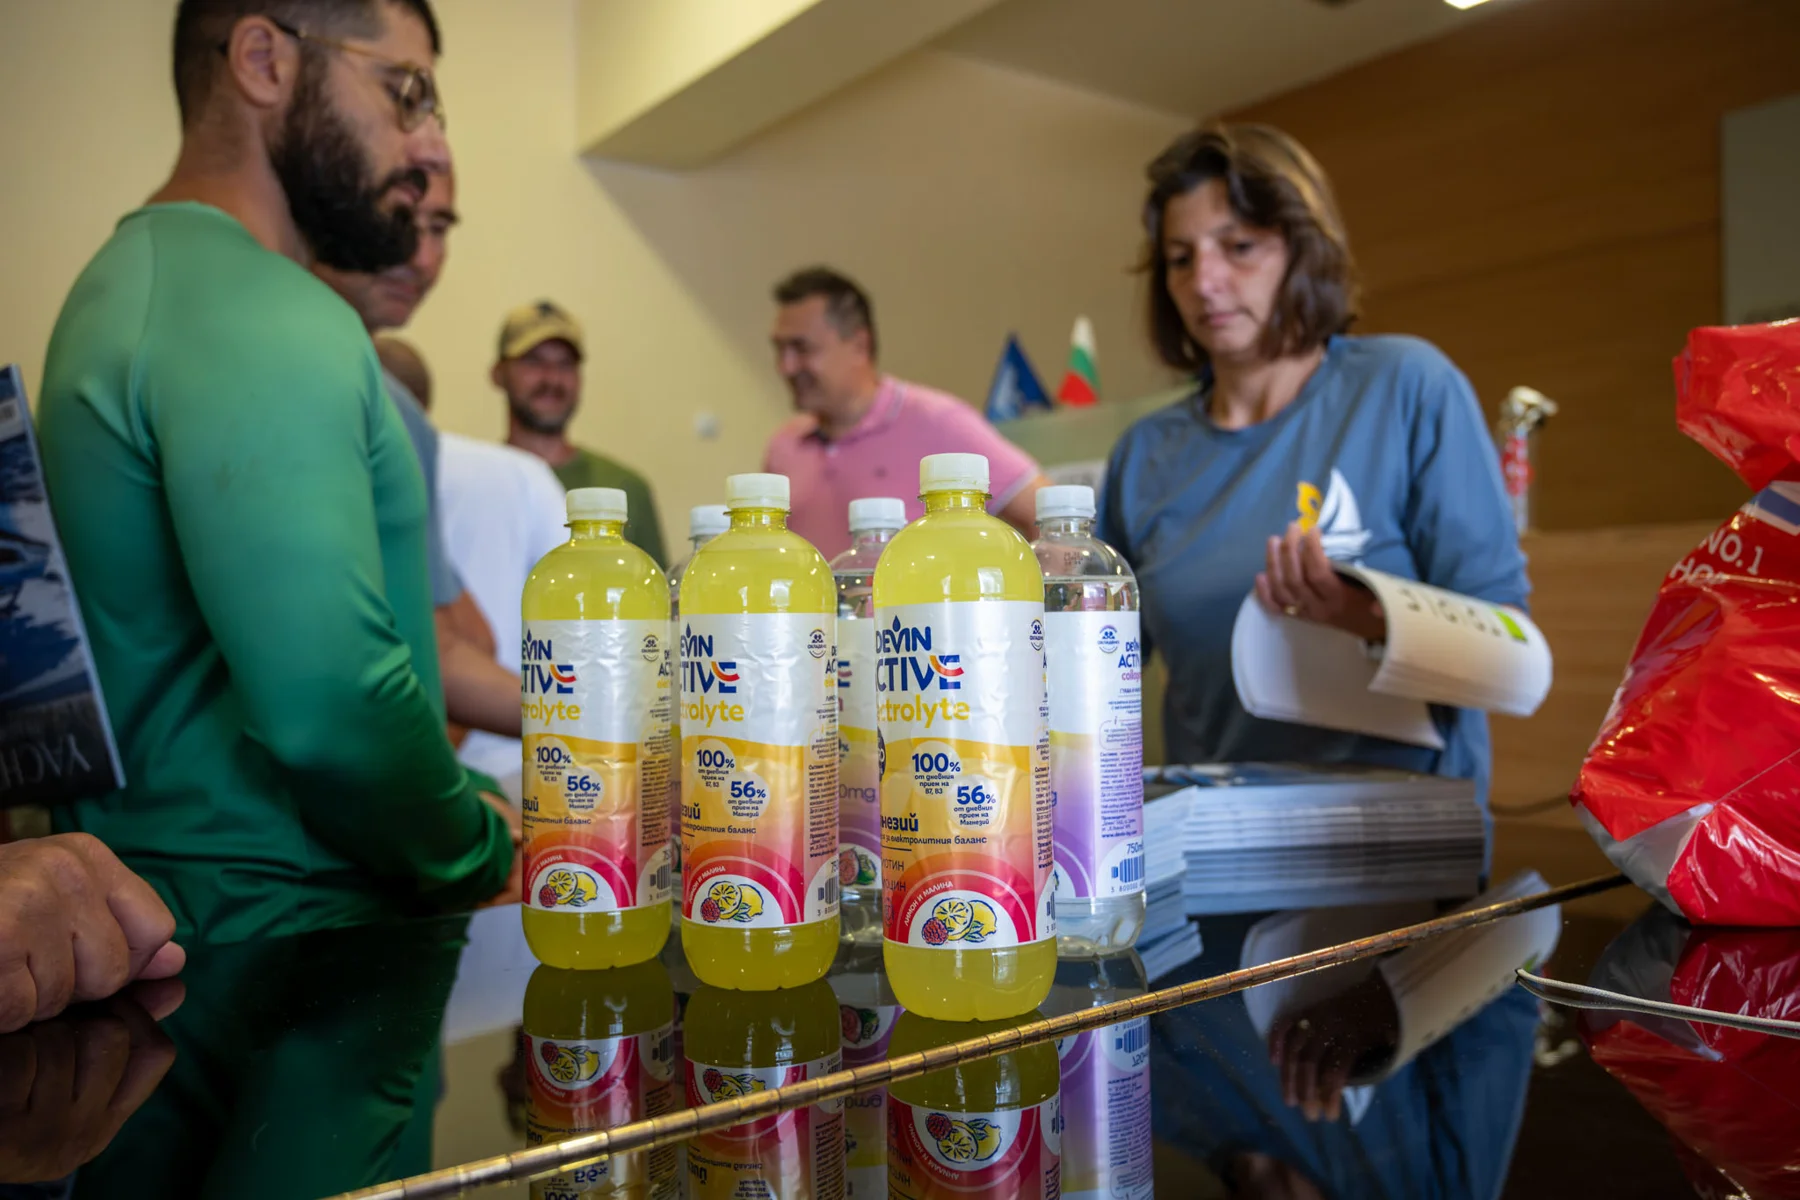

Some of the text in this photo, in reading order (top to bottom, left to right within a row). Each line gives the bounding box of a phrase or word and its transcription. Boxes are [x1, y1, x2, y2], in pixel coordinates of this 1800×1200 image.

[522, 639, 552, 661] EVIN
[680, 635, 713, 659] EVIN
[876, 626, 932, 654] DEVIN
[521, 664, 577, 694] TIVE
[681, 661, 740, 694] TIVE
[876, 654, 965, 692] CTIVE
[521, 696, 581, 726] trolyte
[680, 695, 745, 728] trolyte
[877, 694, 970, 729] ctrolyte
[536, 746, 571, 764] 100%
[696, 749, 735, 769] 100%
[911, 752, 961, 773] 100%
[567, 775, 601, 792] 56%
[730, 781, 766, 799] 56%
[956, 784, 996, 805] 56%
[880, 812, 919, 833] незий
[954, 835, 988, 845] баланс
[922, 880, 954, 897] МАЛИНА
